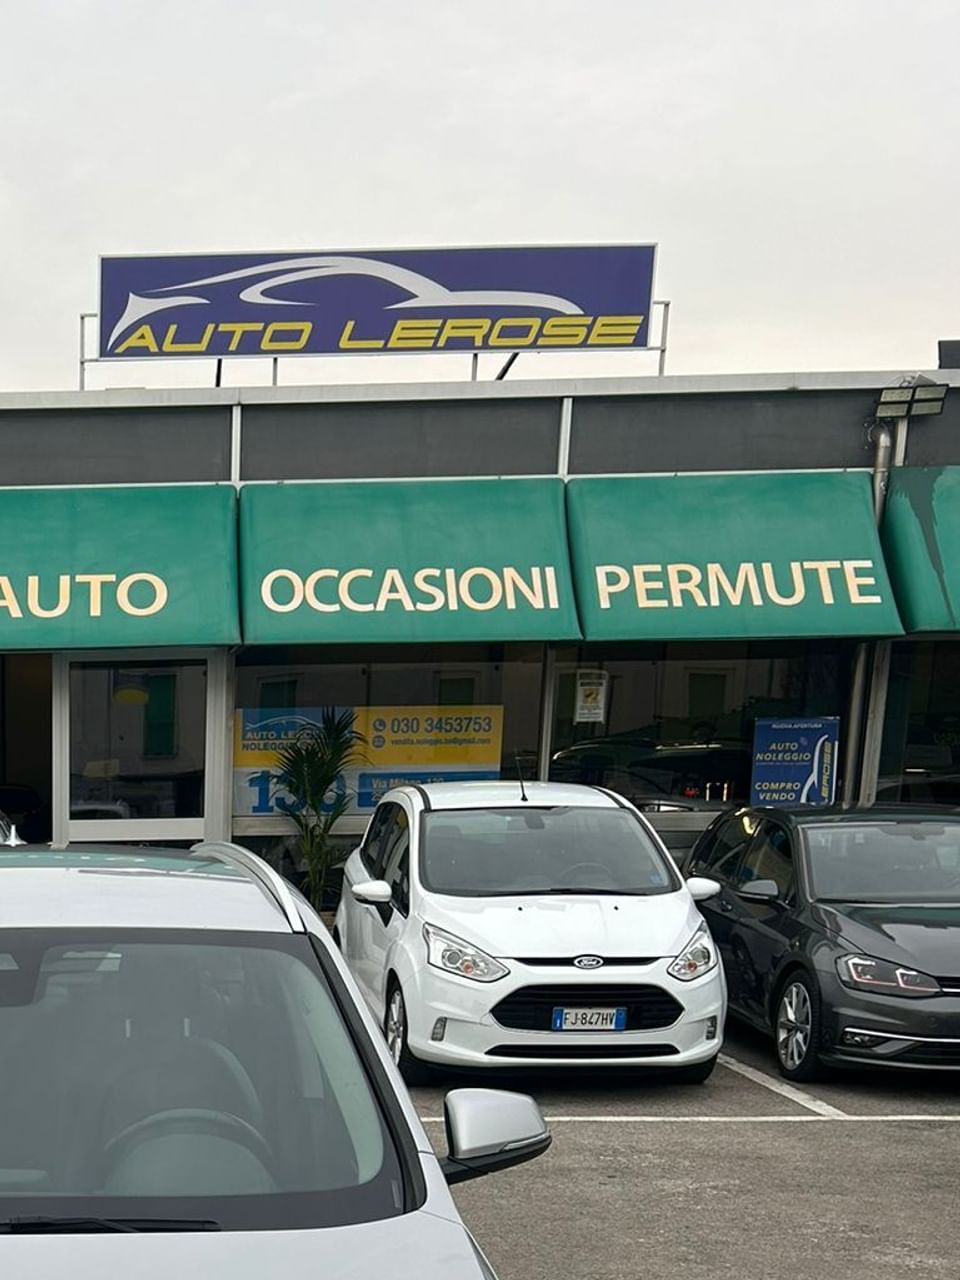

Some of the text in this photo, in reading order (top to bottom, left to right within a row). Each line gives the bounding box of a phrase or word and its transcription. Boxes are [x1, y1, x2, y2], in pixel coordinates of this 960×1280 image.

[115, 314, 644, 353] AUTO LEROSE
[260, 565, 560, 612] OCCASIONI
[594, 559, 882, 609] PERMUTE
[391, 716, 493, 733] 030 3453753
[245, 731, 277, 739] AUTO
[769, 742, 798, 751] AUTO
[755, 752, 811, 761] NOLEGGIO
[755, 782, 800, 791] COMPRO
[759, 792, 795, 800] VENDO
